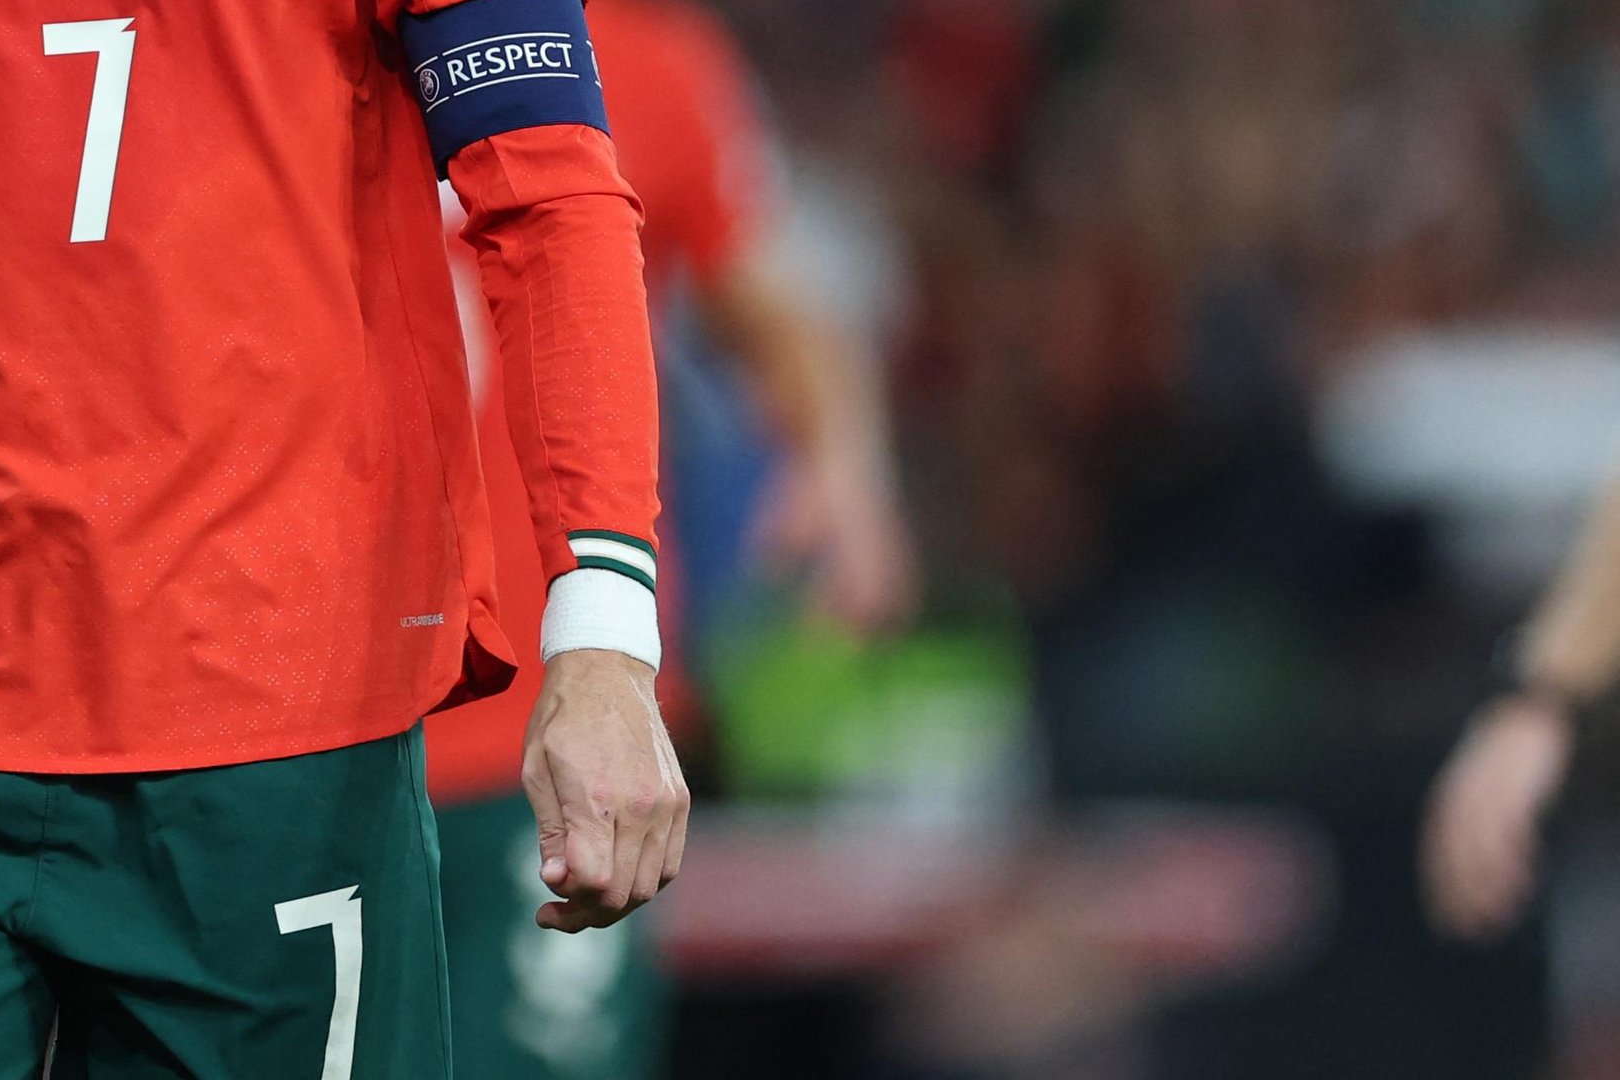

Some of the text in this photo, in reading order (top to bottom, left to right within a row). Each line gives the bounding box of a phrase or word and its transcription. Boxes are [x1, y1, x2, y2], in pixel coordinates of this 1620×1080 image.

[42, 17, 136, 243] 7
[446, 41, 572, 86] RESPECT
[274, 884, 363, 1080] 7
